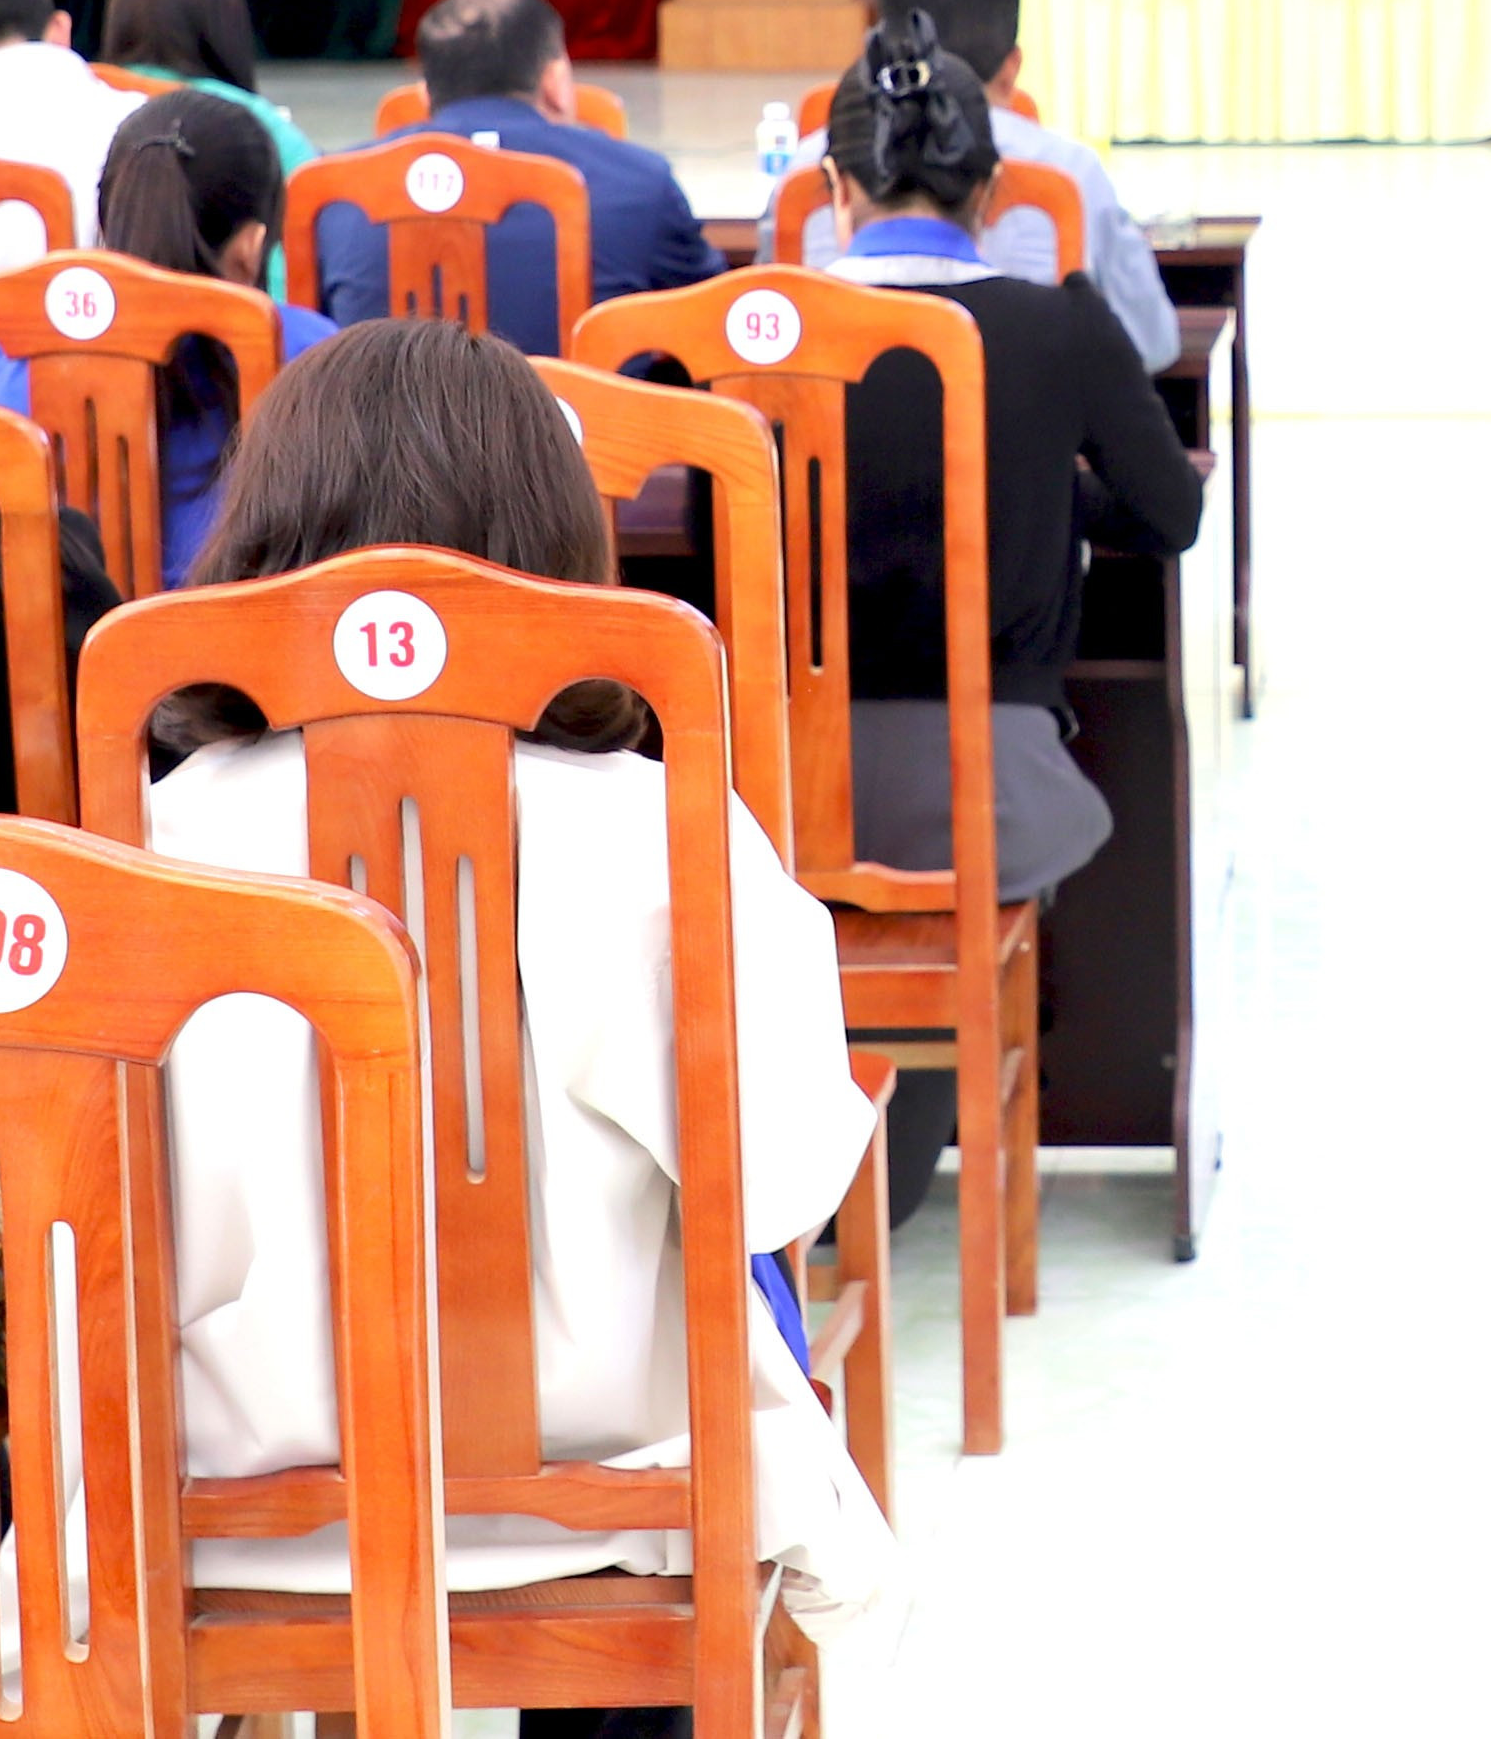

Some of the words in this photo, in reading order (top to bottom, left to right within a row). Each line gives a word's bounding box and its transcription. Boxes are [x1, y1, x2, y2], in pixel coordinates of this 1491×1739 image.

[64, 292, 97, 319] 36
[745, 314, 781, 342] 93
[358, 621, 416, 668] 13
